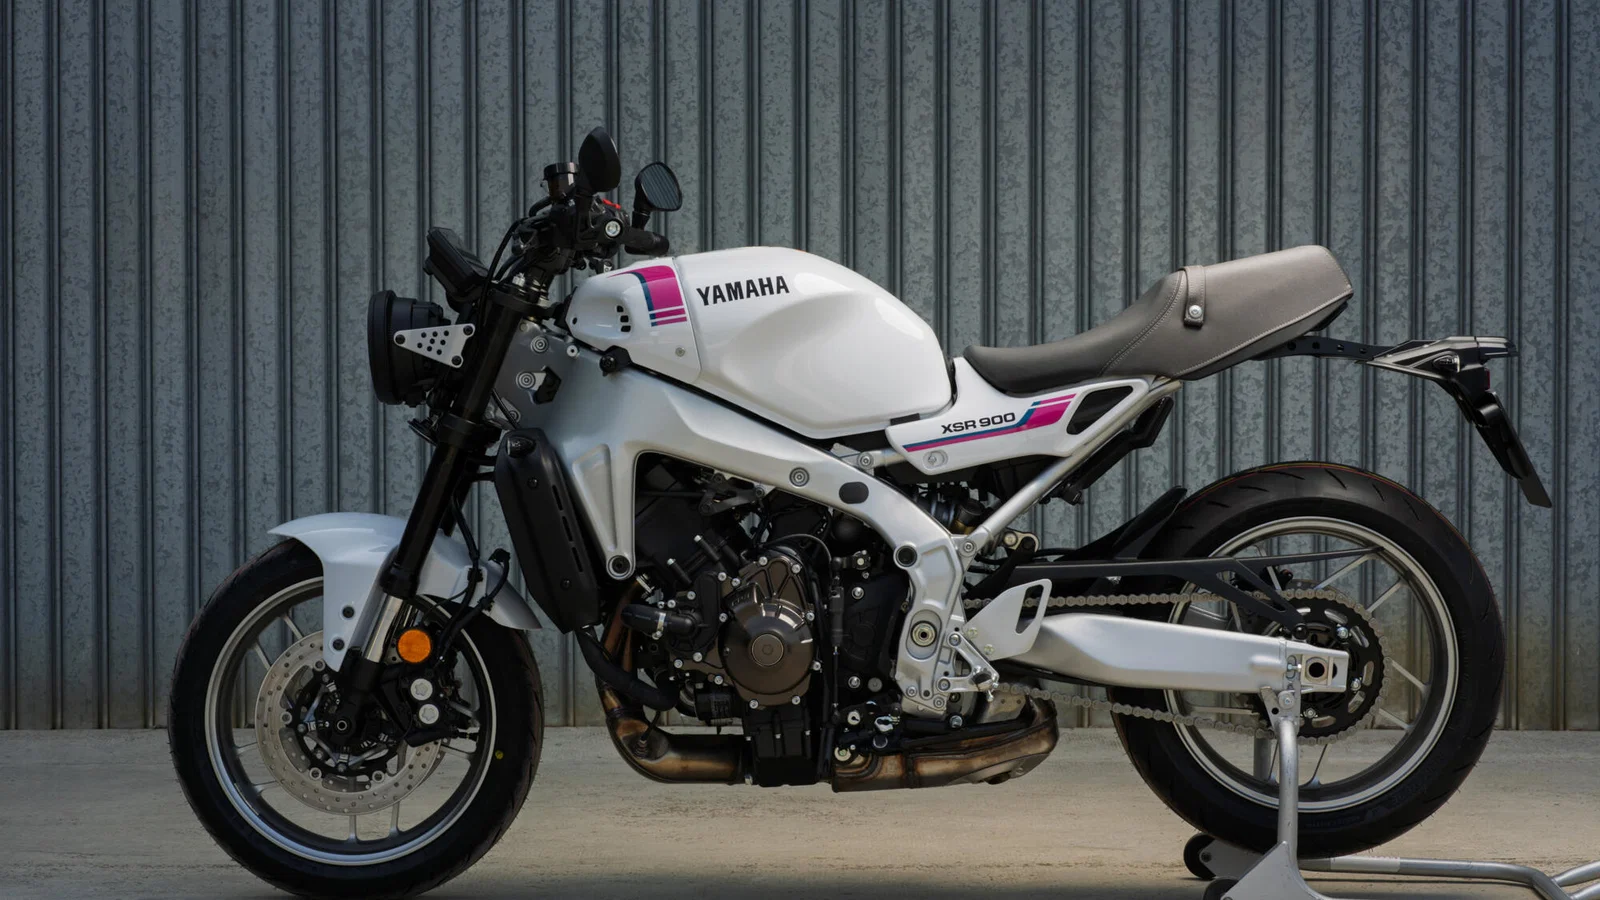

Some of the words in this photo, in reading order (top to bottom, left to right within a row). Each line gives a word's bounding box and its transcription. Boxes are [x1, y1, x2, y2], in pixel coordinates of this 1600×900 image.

[696, 275, 790, 306] YAMAHA
[941, 420, 977, 434] XSR
[979, 412, 1016, 427] 900
